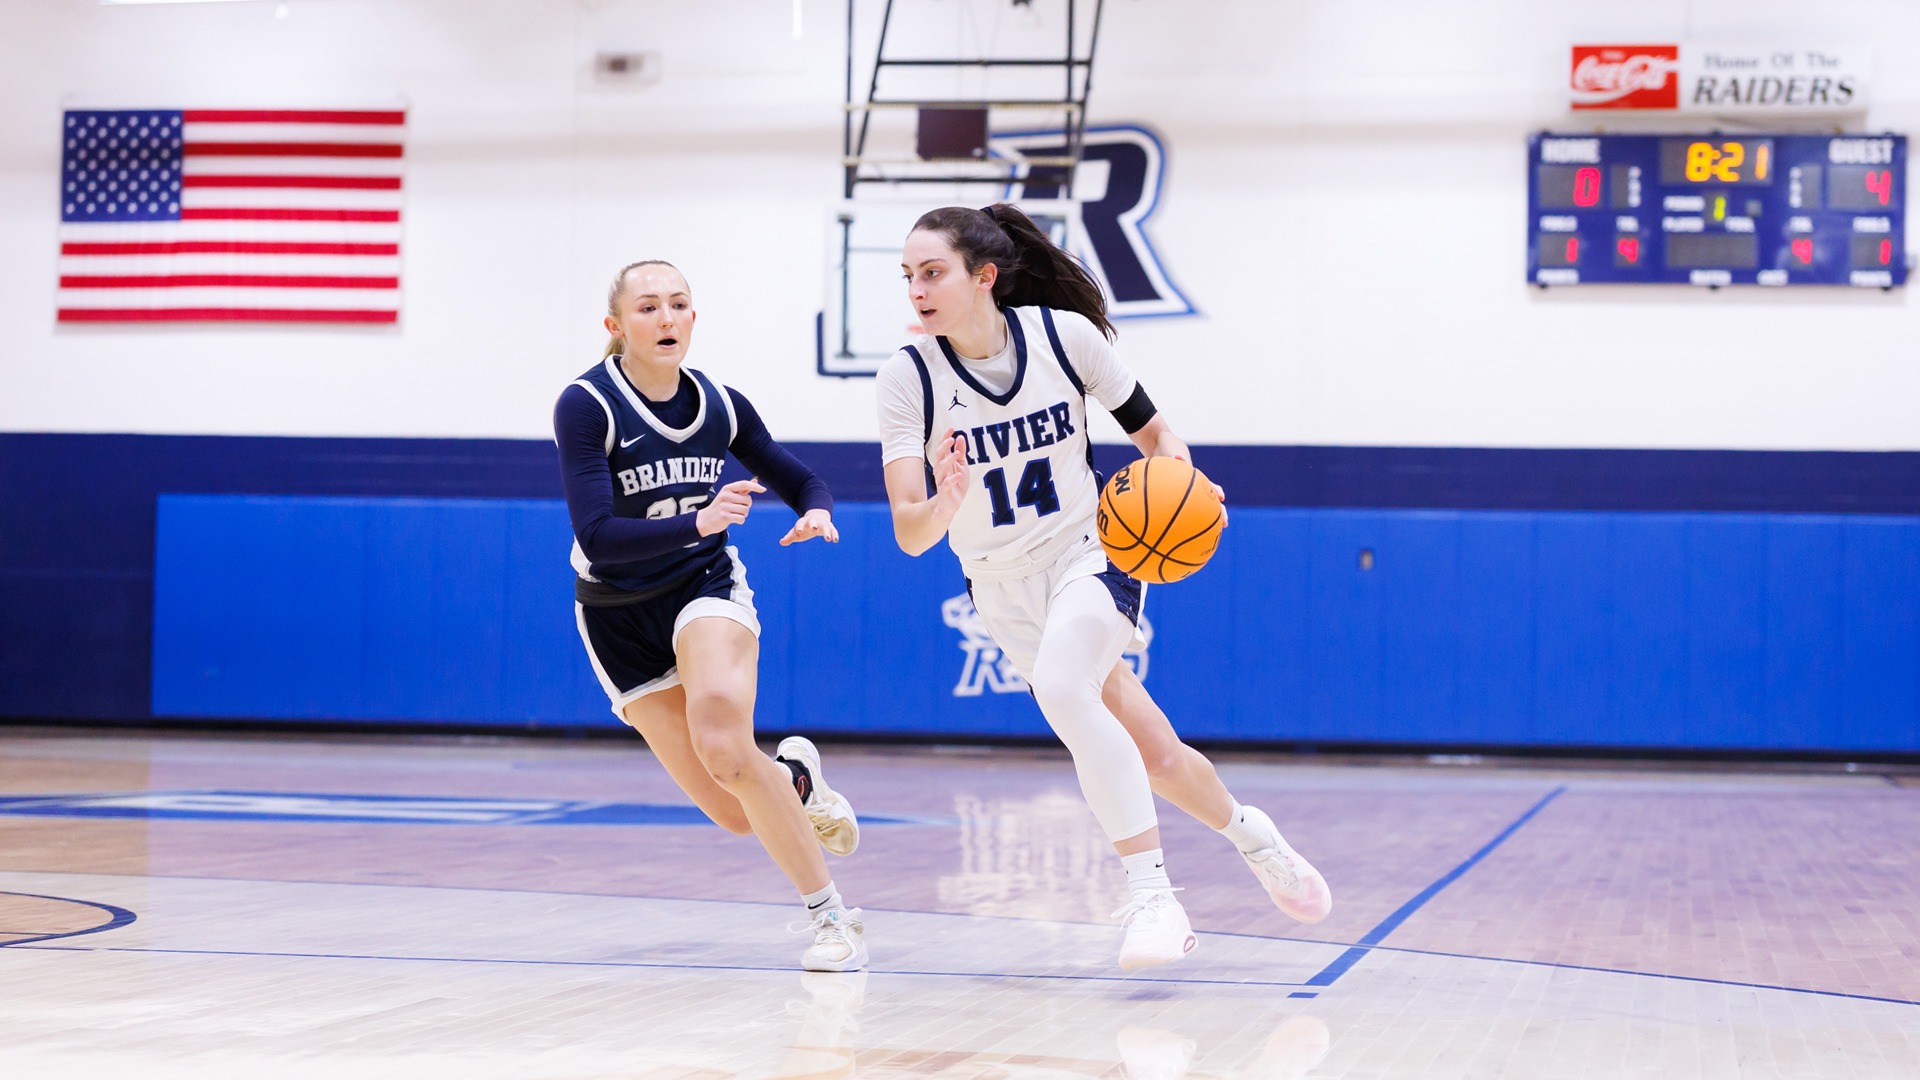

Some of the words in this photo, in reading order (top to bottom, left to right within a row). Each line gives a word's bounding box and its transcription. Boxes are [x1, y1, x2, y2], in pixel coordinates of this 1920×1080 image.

[1704, 51, 1759, 69] Home
[1807, 51, 1841, 68] The
[1693, 75, 1856, 105] RAIDERS
[1685, 142, 1769, 182] 8:21
[1573, 167, 1601, 207] 0
[1865, 170, 1891, 205] 4
[990, 126, 1197, 318] R
[1713, 196, 1726, 222] 1
[1566, 238, 1579, 263] 1
[1879, 239, 1892, 265] 1
[983, 456, 1060, 527] 14
